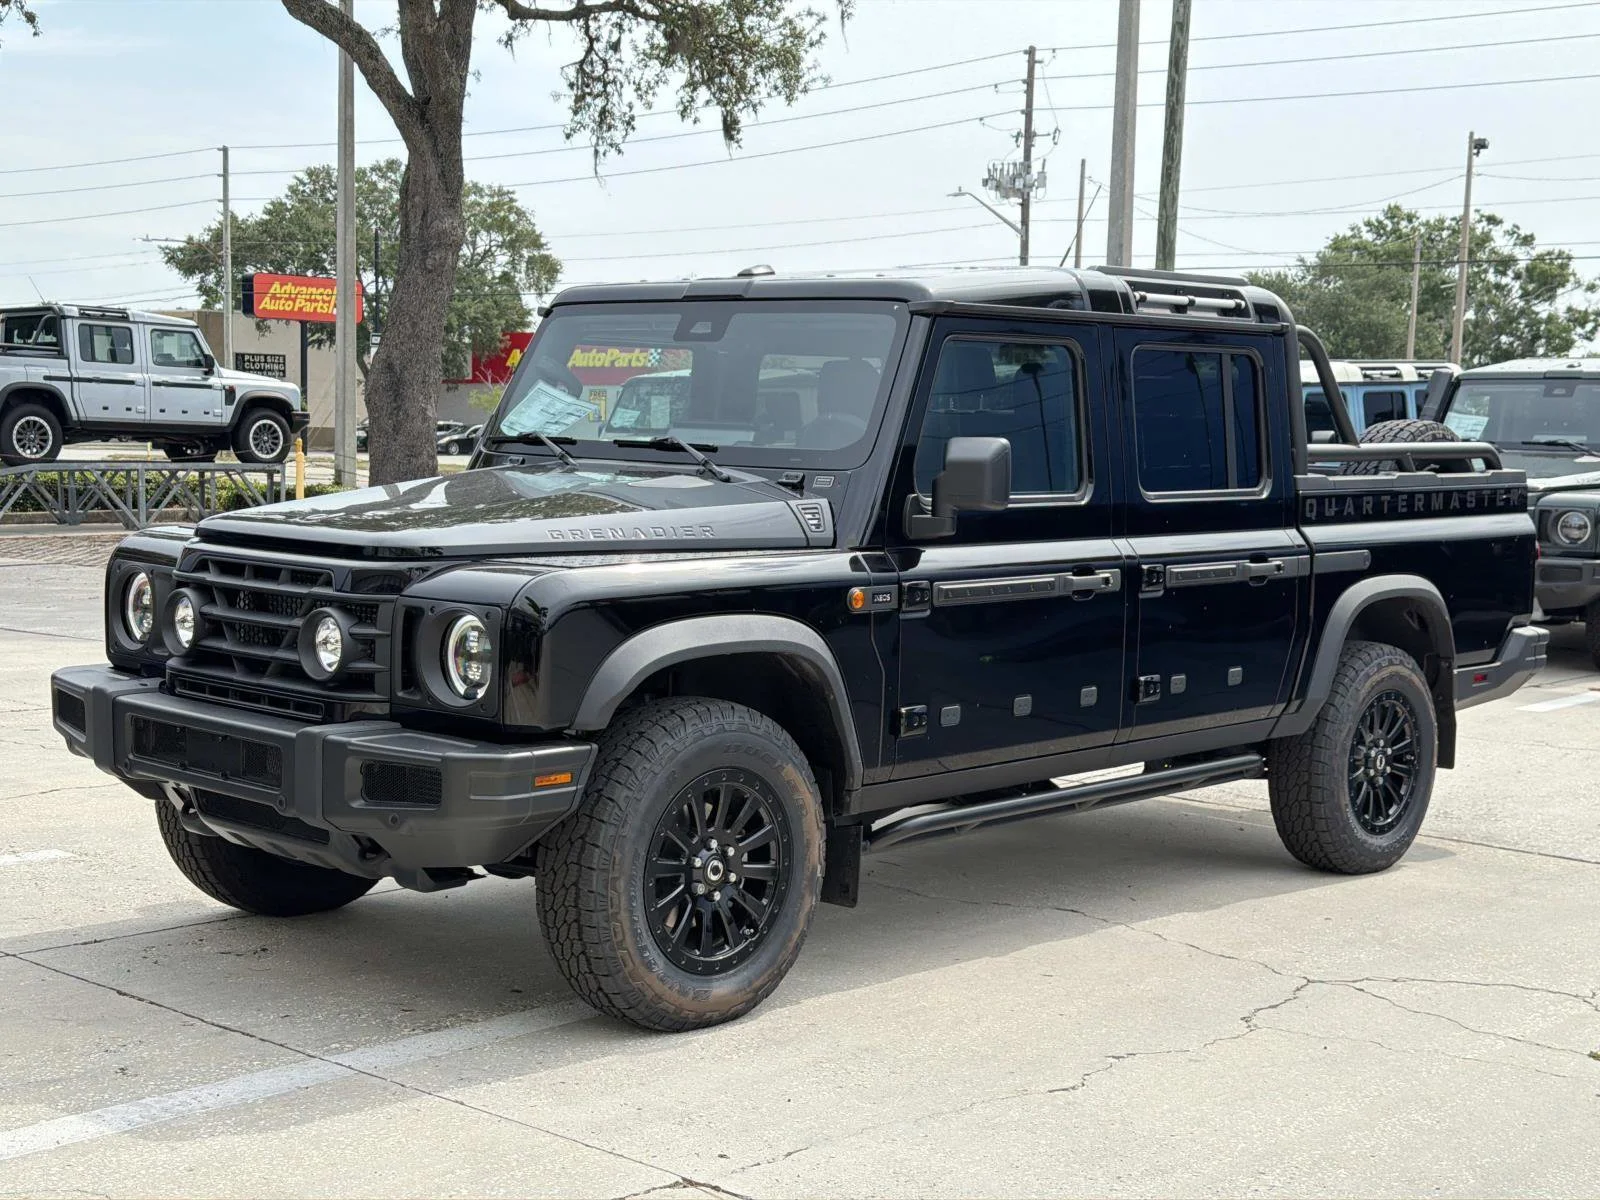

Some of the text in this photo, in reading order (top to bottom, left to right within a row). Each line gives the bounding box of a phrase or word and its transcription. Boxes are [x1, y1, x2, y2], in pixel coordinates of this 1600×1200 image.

[268, 281, 332, 300] Advance
[259, 297, 330, 313] Auto Parts
[244, 354, 285, 363] PLUS SIZE
[244, 362, 285, 370] CLOTHING
[1305, 489, 1521, 520] QUARTERMASTER
[546, 525, 716, 540] GRENADIER
